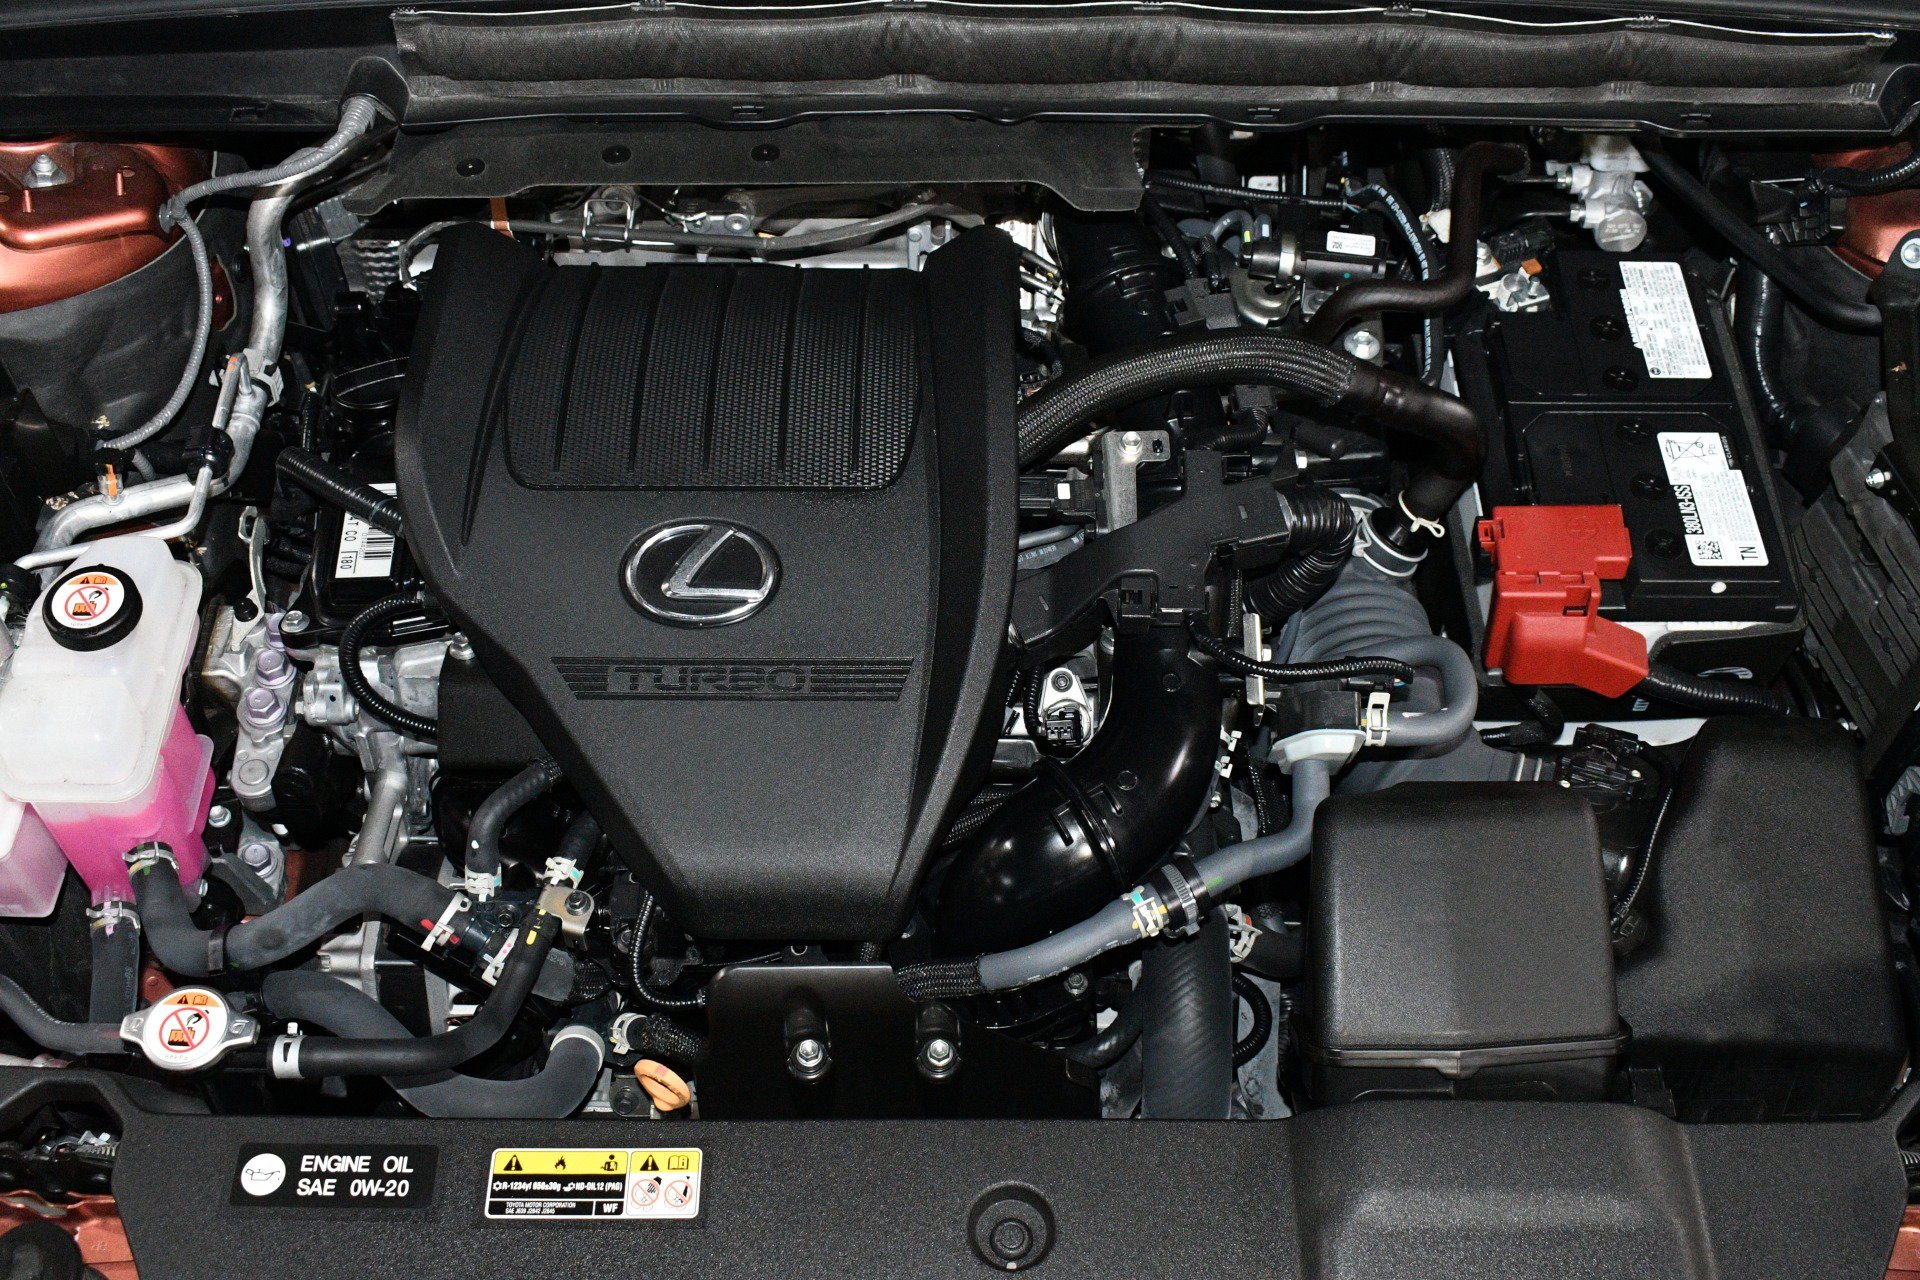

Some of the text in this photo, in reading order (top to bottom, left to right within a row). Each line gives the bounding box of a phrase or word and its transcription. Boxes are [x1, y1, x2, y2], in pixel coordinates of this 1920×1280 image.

[1673, 485, 1703, 534] 380LN3-ISS
[1739, 546, 1758, 560] TN
[612, 665, 806, 693] TURBO
[300, 1155, 414, 1173] ENGINE OIL
[296, 1178, 410, 1197] SAE 0W-20
[603, 1203, 619, 1213] WF
